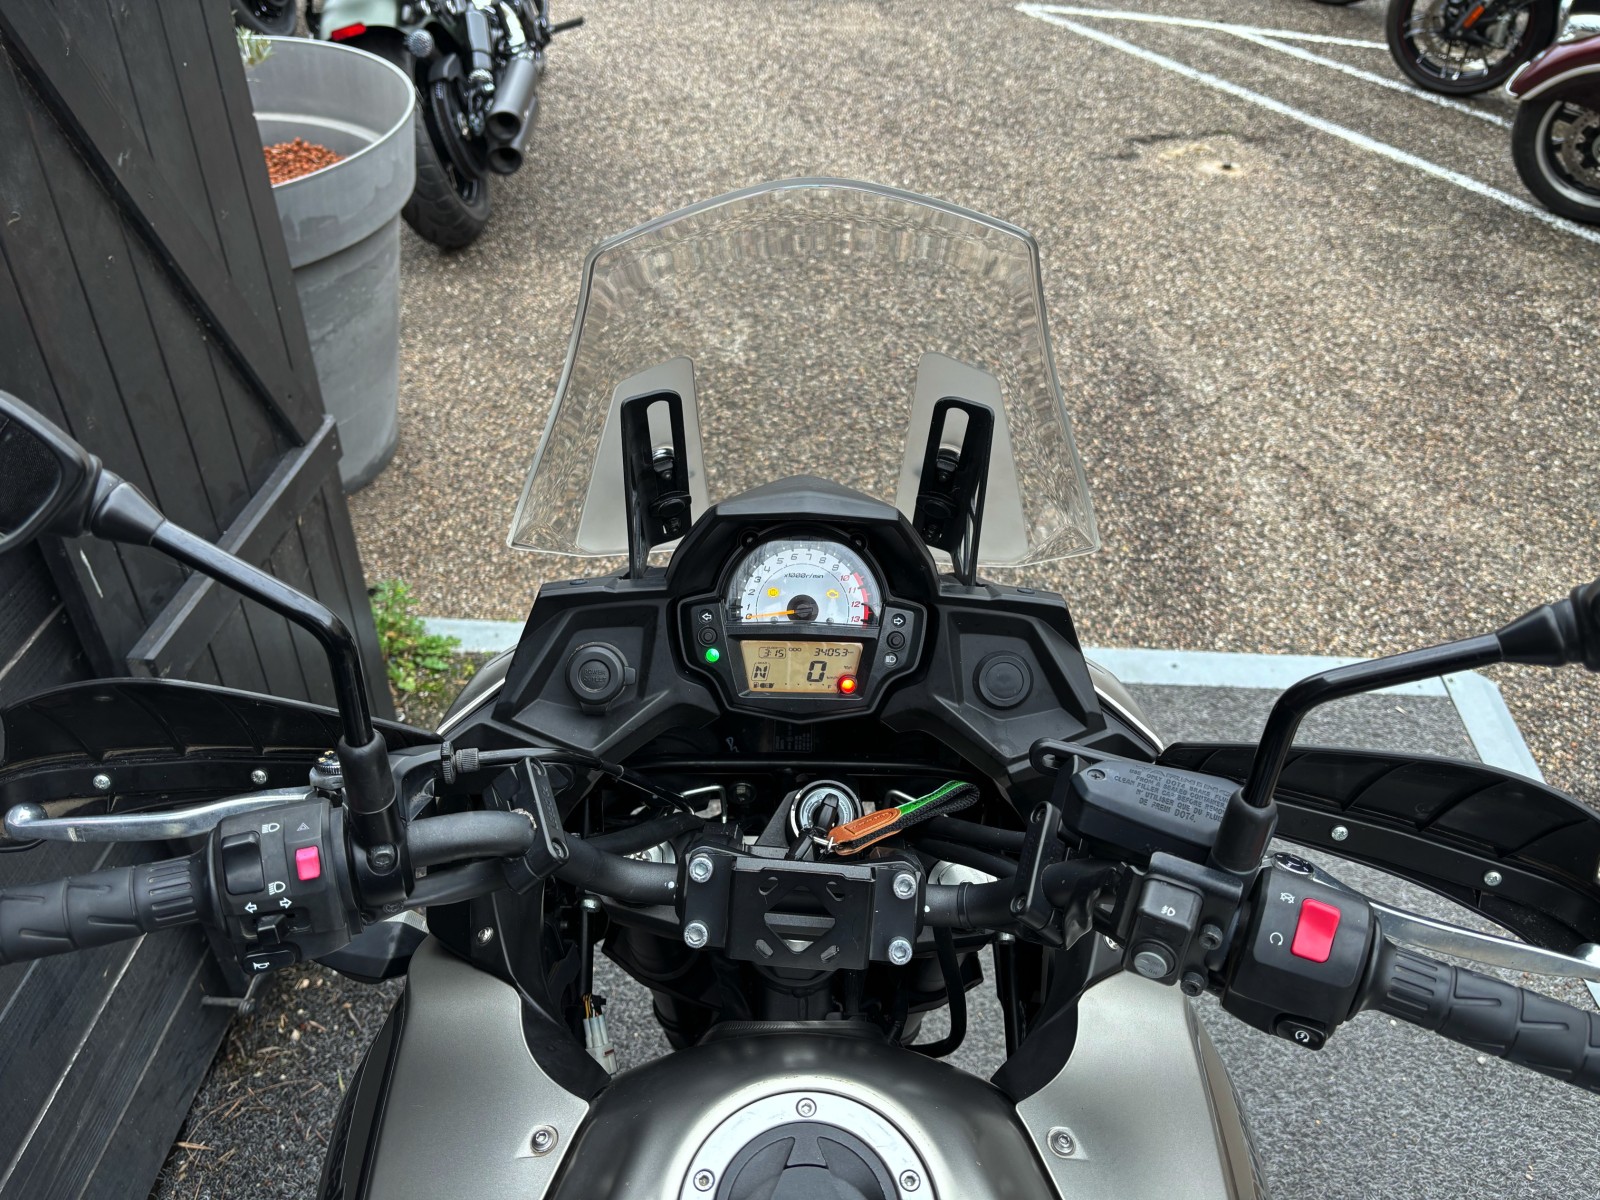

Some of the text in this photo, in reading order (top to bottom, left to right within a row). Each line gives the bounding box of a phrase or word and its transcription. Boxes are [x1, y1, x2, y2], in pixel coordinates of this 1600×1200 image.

[776, 557, 785, 565] 5
[790, 553, 799, 561] 6
[805, 553, 813, 561] 7
[818, 556, 827, 564] 8
[763, 565, 771, 573] 4
[831, 564, 840, 572] 9
[753, 576, 762, 584] 3
[840, 574, 850, 582] 10
[747, 588, 756, 596] 2
[746, 603, 751, 611] 1
[851, 600, 861, 608] 12
[850, 615, 861, 623] 13
[814, 647, 849, 657] 34053
[753, 665, 768, 679] N
[806, 660, 828, 682] 0
[1166, 779, 1186, 789] DOT4
[1139, 797, 1149, 806] DE
[1177, 802, 1191, 812] QUE
[1193, 807, 1203, 816] DU
